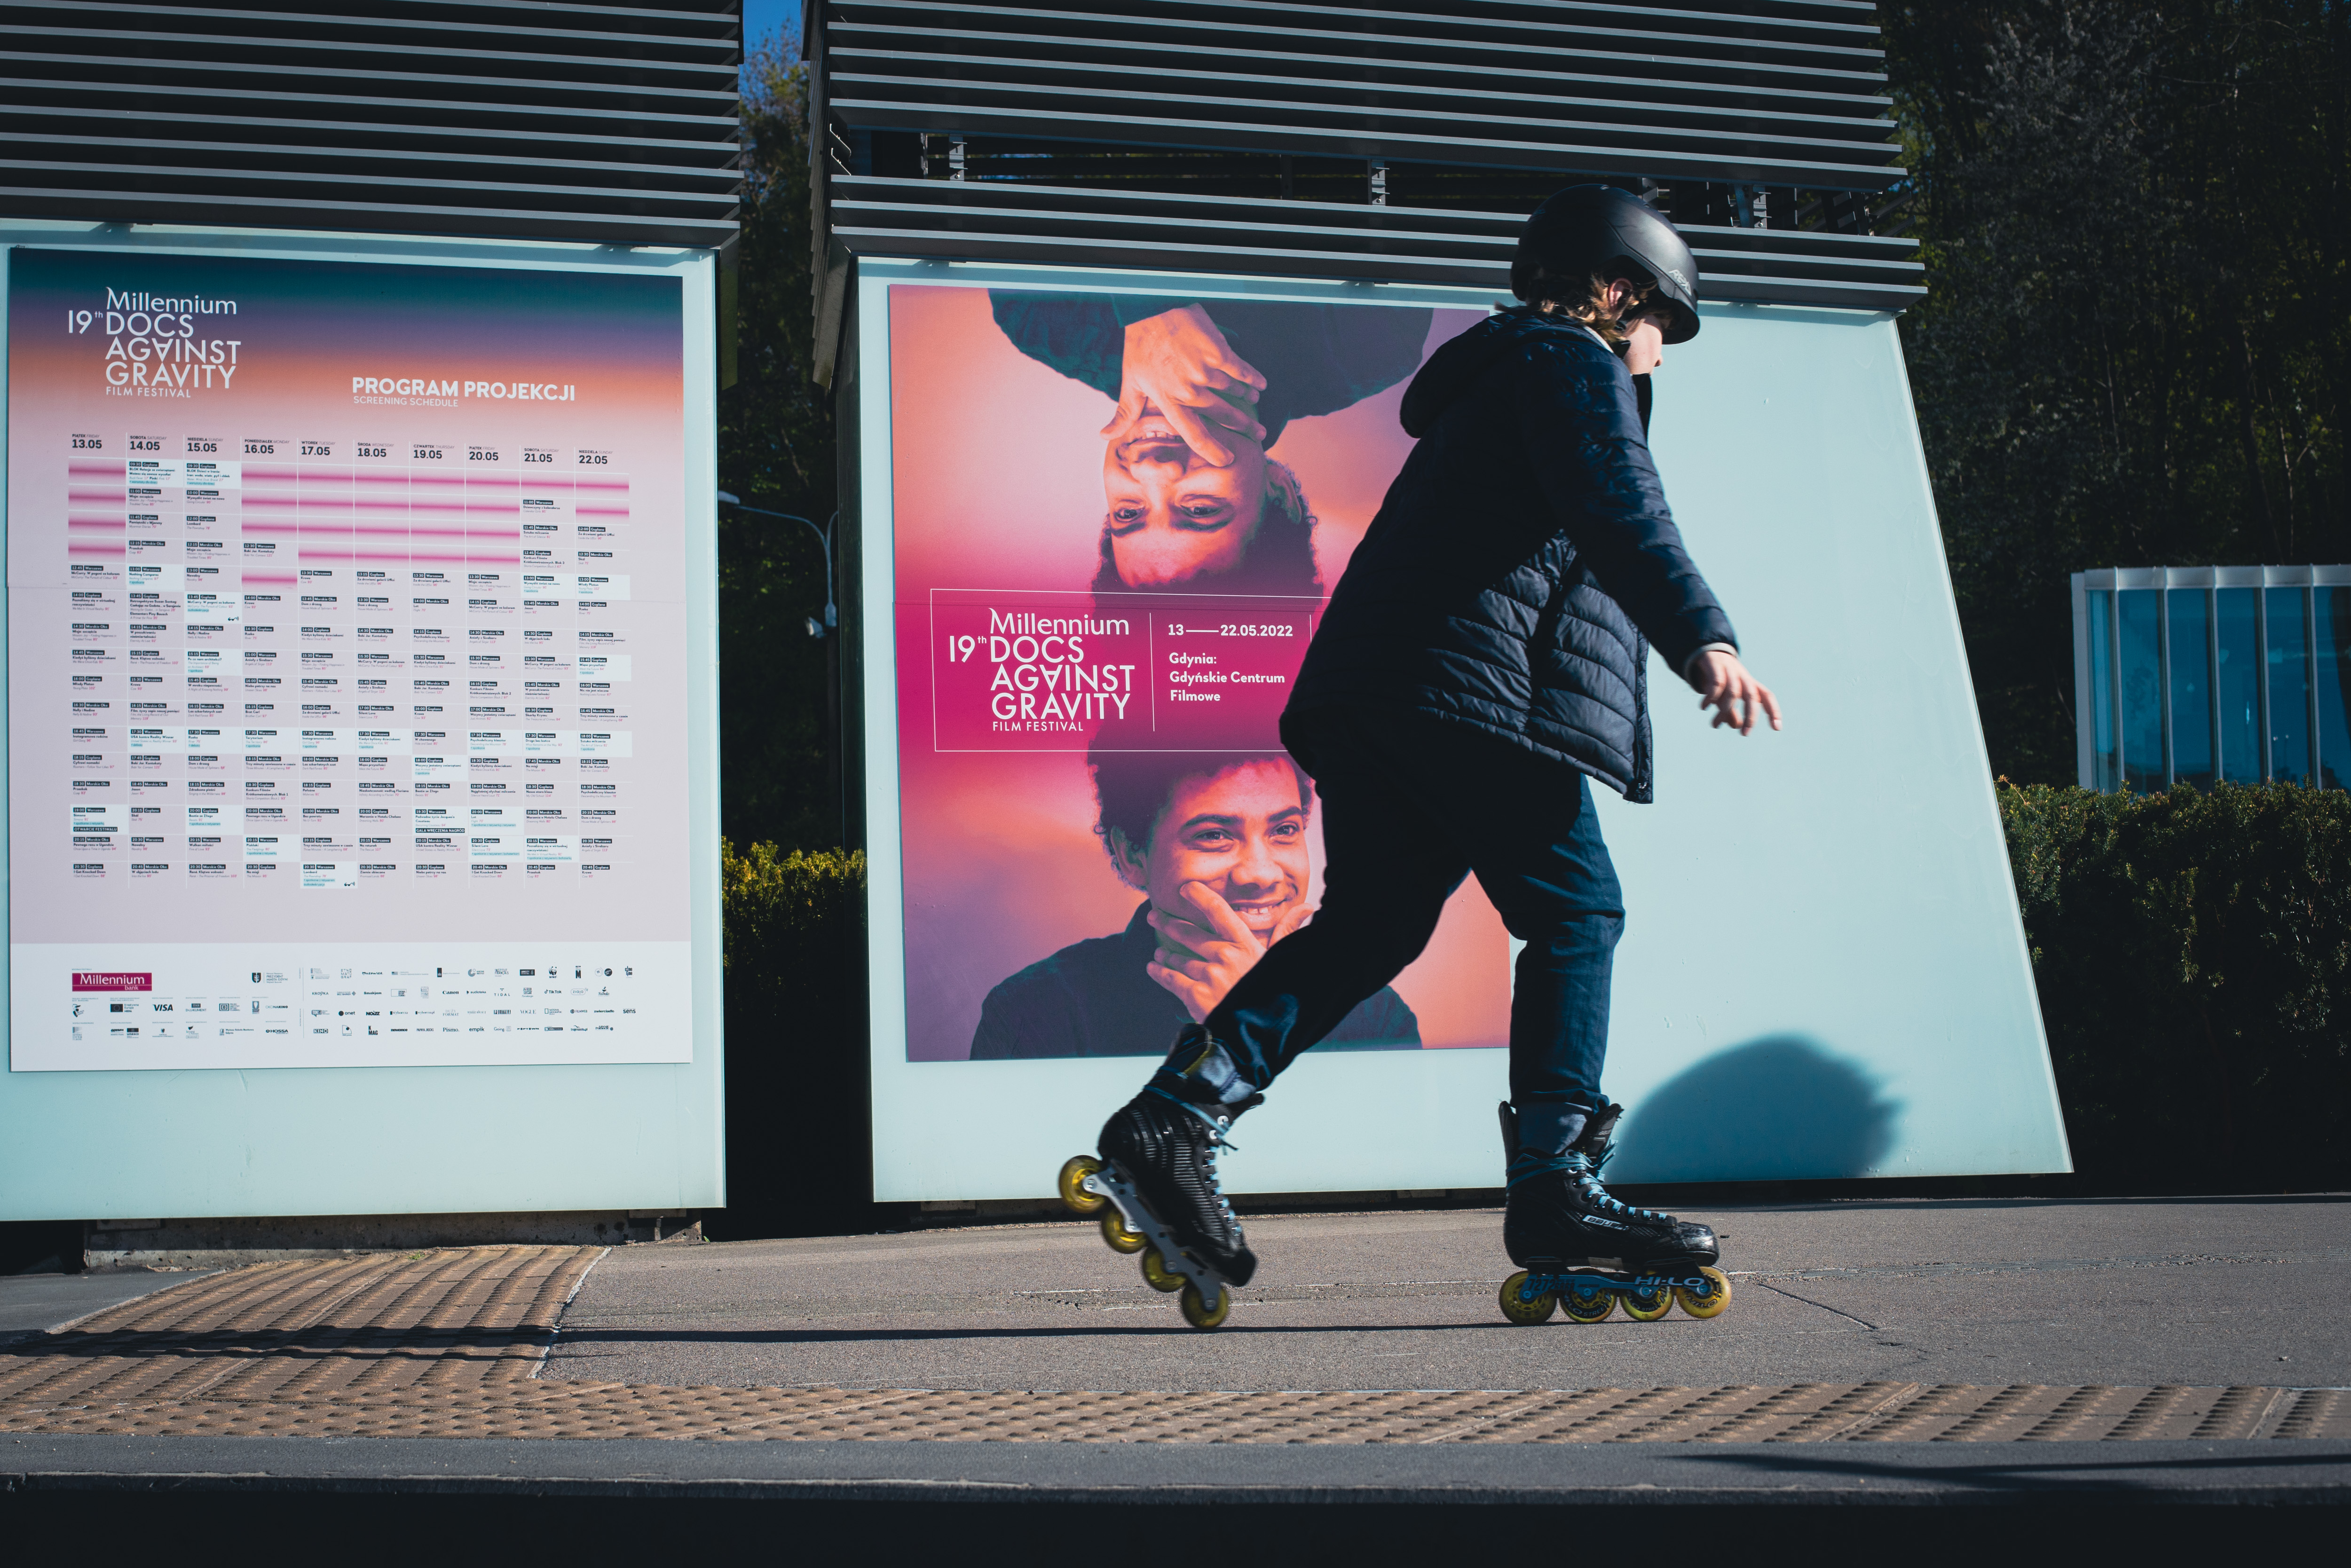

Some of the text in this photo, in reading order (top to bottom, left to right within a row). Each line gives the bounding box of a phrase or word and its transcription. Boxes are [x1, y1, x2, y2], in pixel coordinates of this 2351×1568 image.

[106, 287, 237, 315] Millennium
[106, 311, 194, 338] DOCS
[106, 361, 236, 389] GRAVITY
[106, 386, 191, 398] FILM FESTIVAL
[352, 377, 575, 401] PROGRAM PROJEKCJI
[354, 396, 458, 407] SCREENING SCHEDULE
[72, 439, 102, 449] 13.05
[130, 441, 160, 450] 14.05
[187, 442, 217, 452] 15.05
[245, 444, 274, 454] 16.05
[301, 446, 330, 456] 17.05
[357, 448, 387, 457] 18.05
[413, 449, 442, 459] 19.05
[469, 451, 499, 461] 20.05
[524, 453, 552, 463] 21.05
[579, 455, 607, 465] 22.05
[989, 607, 1129, 635] Millennium
[990, 636, 1084, 663] DOCS
[1169, 652, 1217, 668] Gdynia:
[1169, 671, 1285, 686] Gdyńskie Centrum
[1170, 690, 1221, 701] Filmowe
[992, 692, 1130, 720] GRAVITY
[993, 721, 1083, 731] FILM FESTIVAL
[80, 973, 144, 985] Millennium
[1529, 1278, 1555, 1291] 7272
[1634, 1276, 1705, 1286] HI-LO
